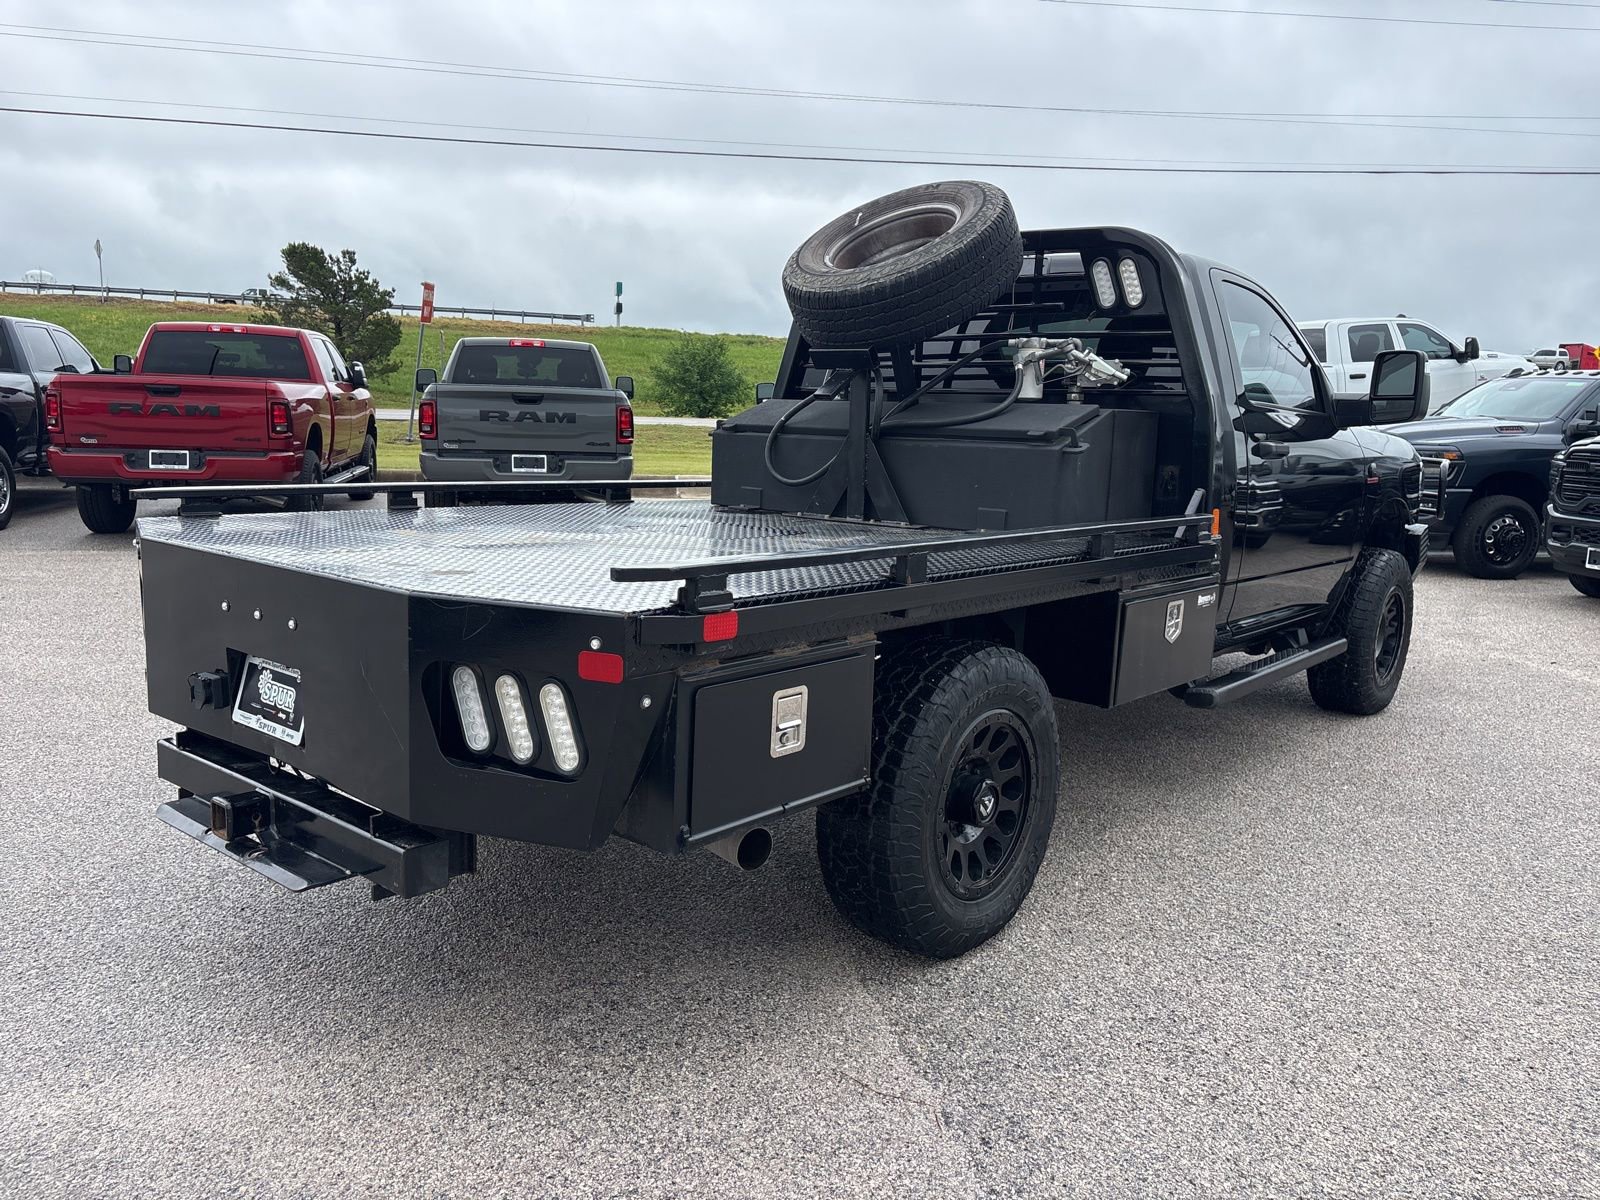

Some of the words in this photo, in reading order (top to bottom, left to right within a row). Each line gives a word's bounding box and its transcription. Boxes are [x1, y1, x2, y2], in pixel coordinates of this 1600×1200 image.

[110, 402, 219, 416] RAM
[480, 410, 576, 423] RAM
[262, 682, 295, 709] SPUR
[258, 721, 277, 734] SPUR
